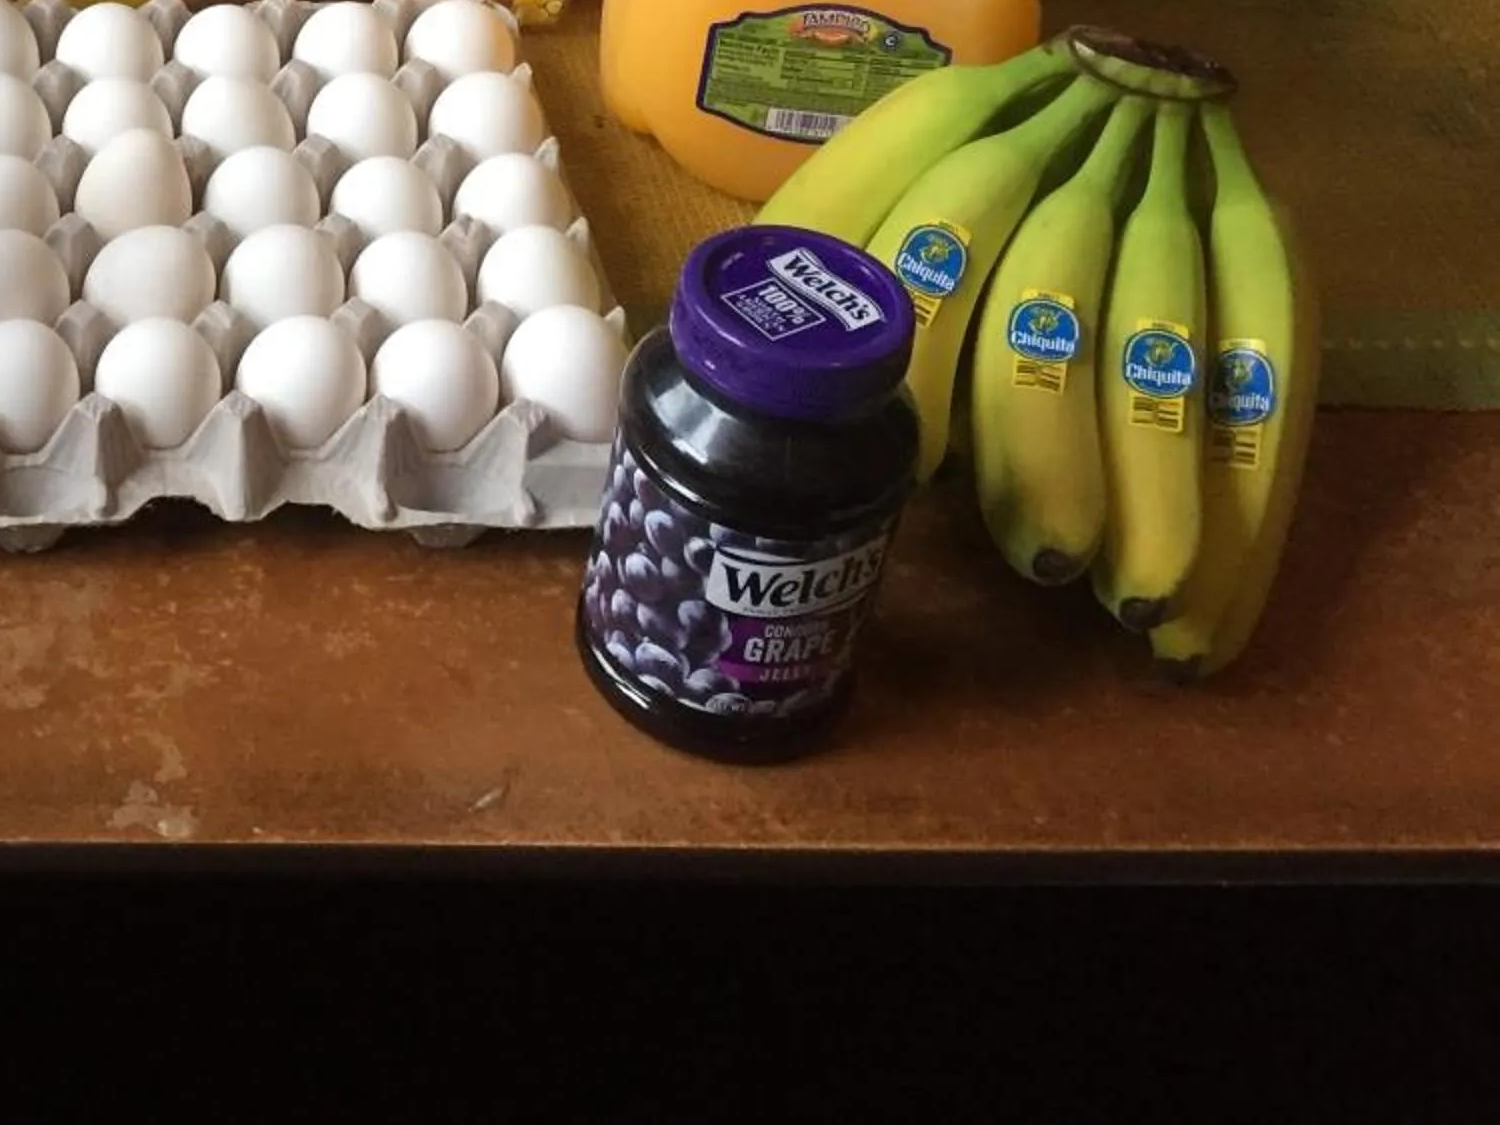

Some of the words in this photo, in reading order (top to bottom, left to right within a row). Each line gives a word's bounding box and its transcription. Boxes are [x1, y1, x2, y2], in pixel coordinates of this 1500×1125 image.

[783, 255, 871, 321] Welch's
[898, 253, 956, 292] Chiquita
[758, 285, 809, 325] 100%
[1011, 331, 1076, 354] Chiquita
[1126, 363, 1192, 386] Chiquita
[1209, 392, 1271, 413] Chiquita
[722, 548, 882, 608] Welch's
[744, 630, 835, 663] GRAPE
